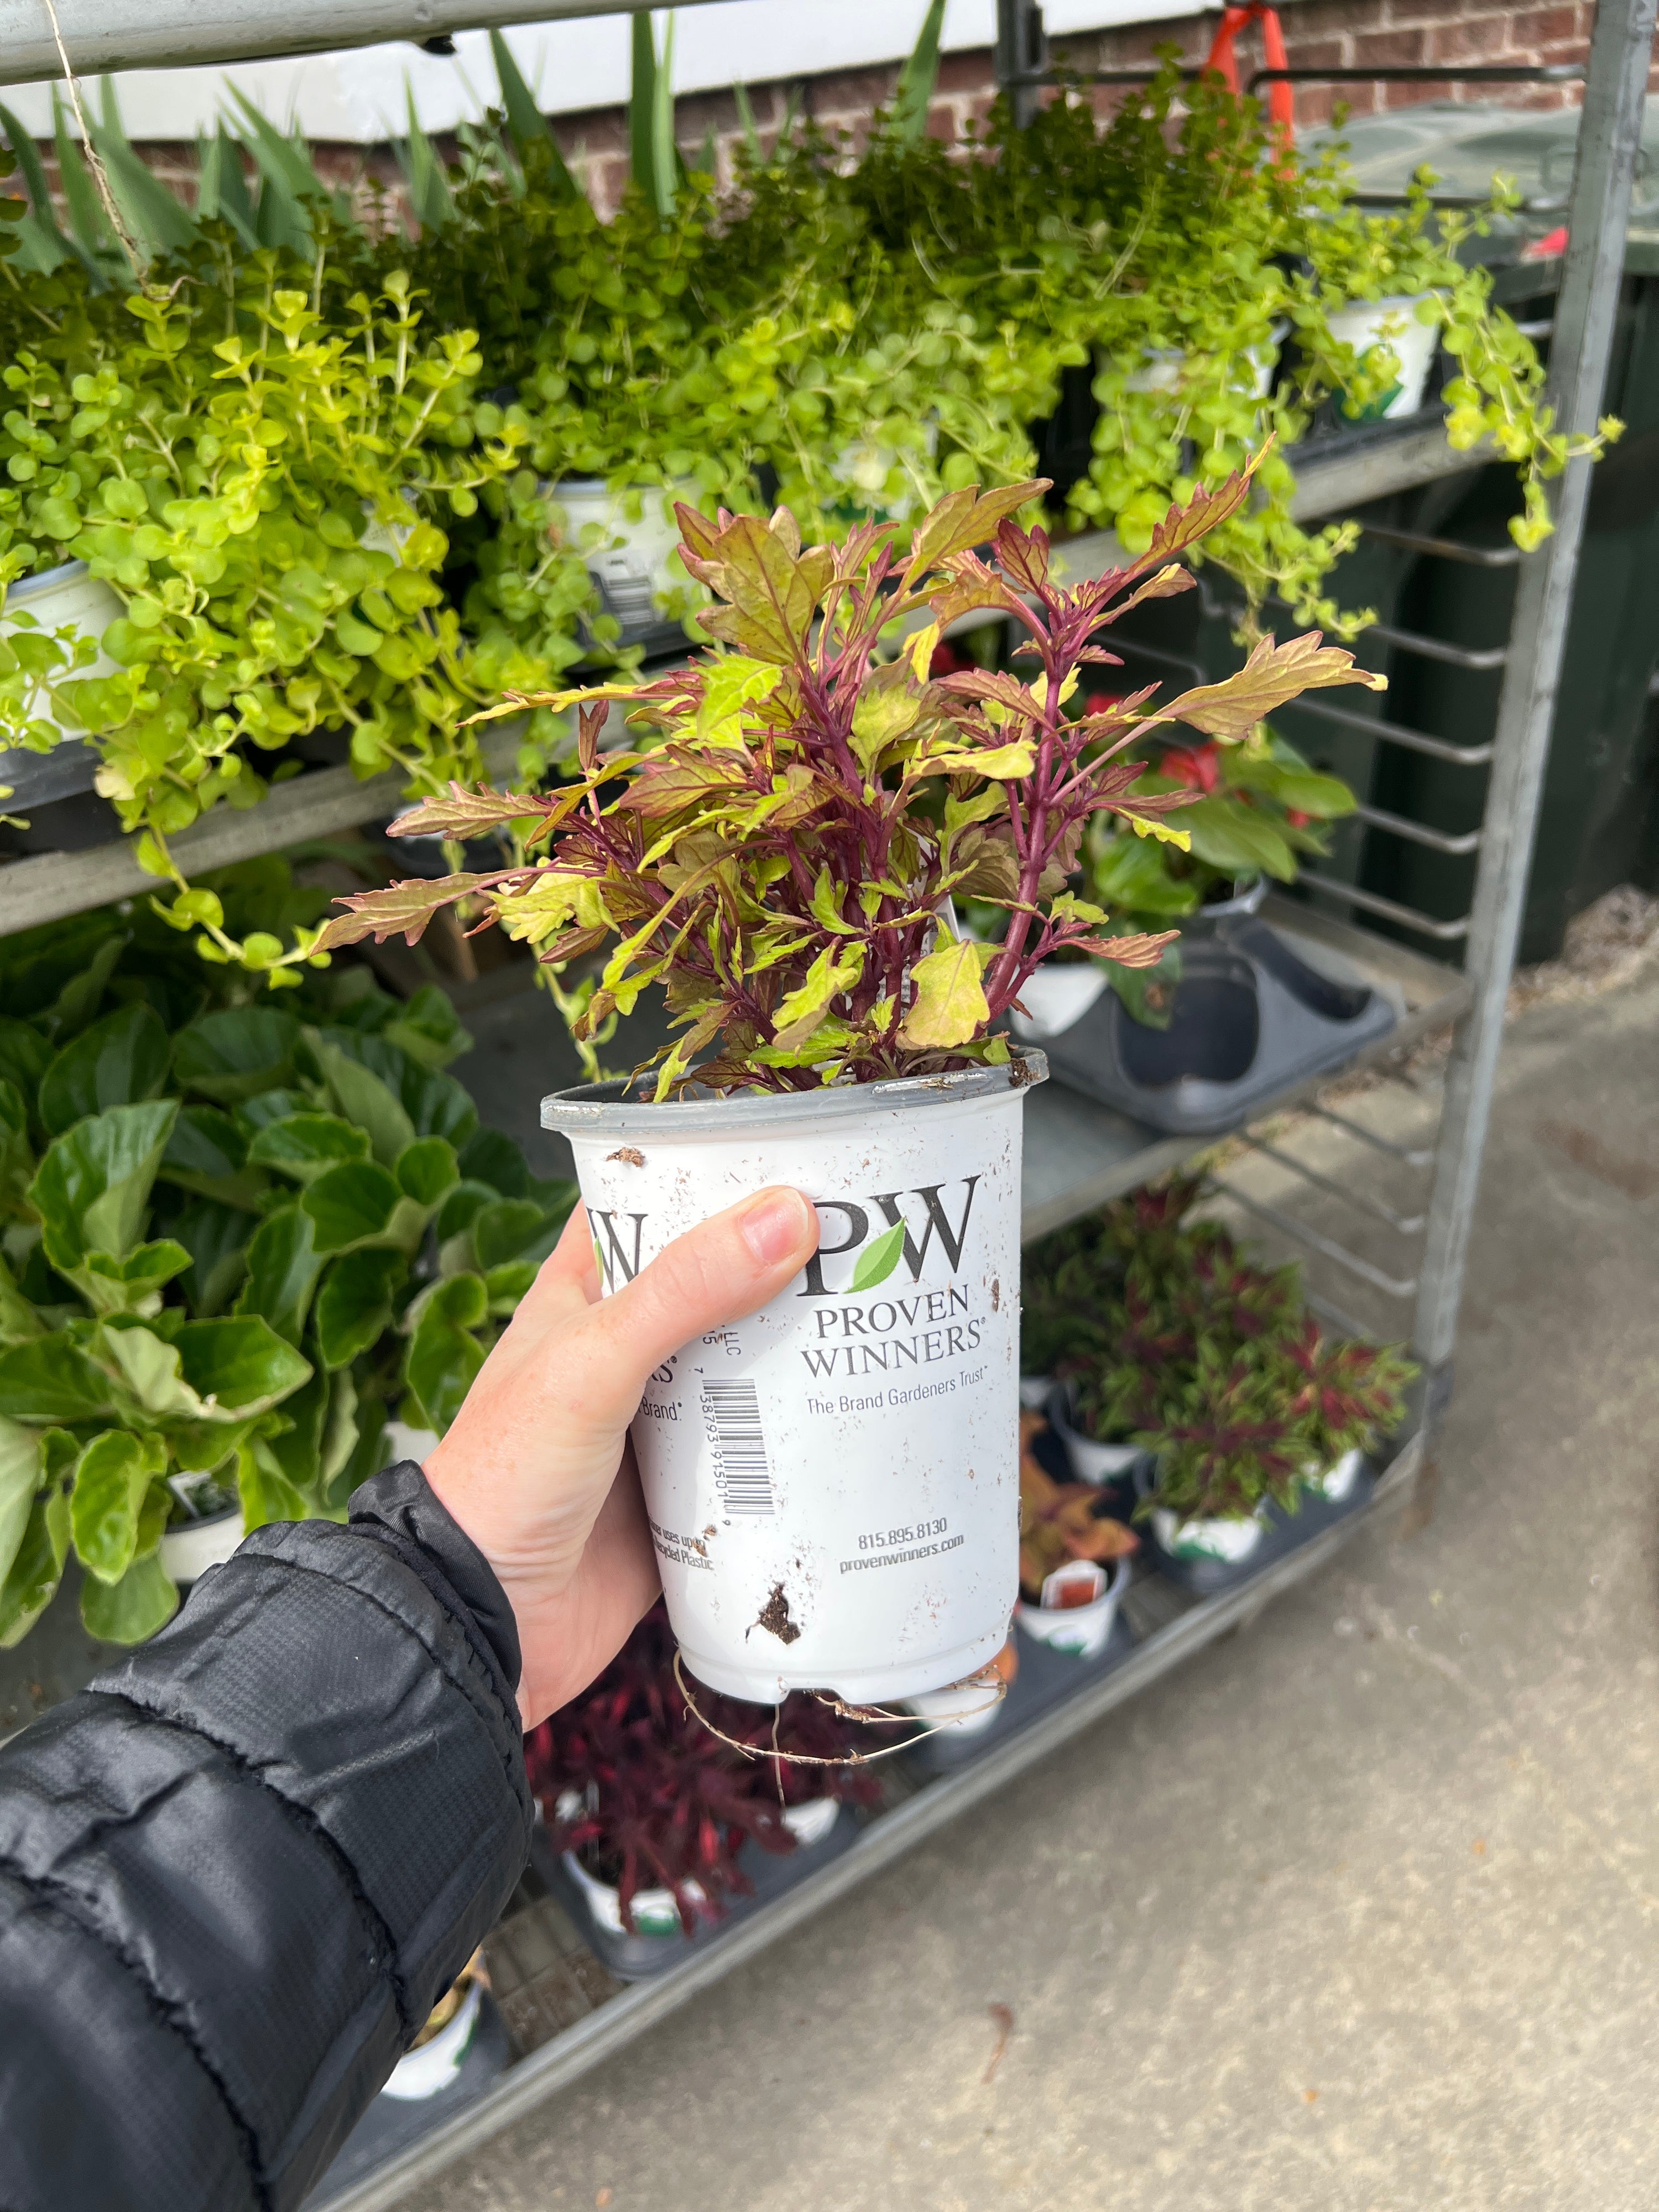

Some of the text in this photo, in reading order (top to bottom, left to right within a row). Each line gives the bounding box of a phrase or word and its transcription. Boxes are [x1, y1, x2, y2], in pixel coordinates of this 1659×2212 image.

[796, 1175, 981, 1296] PW
[813, 1284, 968, 1338] PROVEN
[724, 1332, 741, 1355] LLC
[807, 1398, 834, 1414] The
[839, 1391, 883, 1412] Brand
[888, 1379, 956, 1406] Gardeners
[662, 1528, 680, 1545] uses
[858, 1517, 947, 1550] 815.895.8130
[681, 1550, 714, 1571] Plastic
[839, 1535, 964, 1574] provenwinners.com
